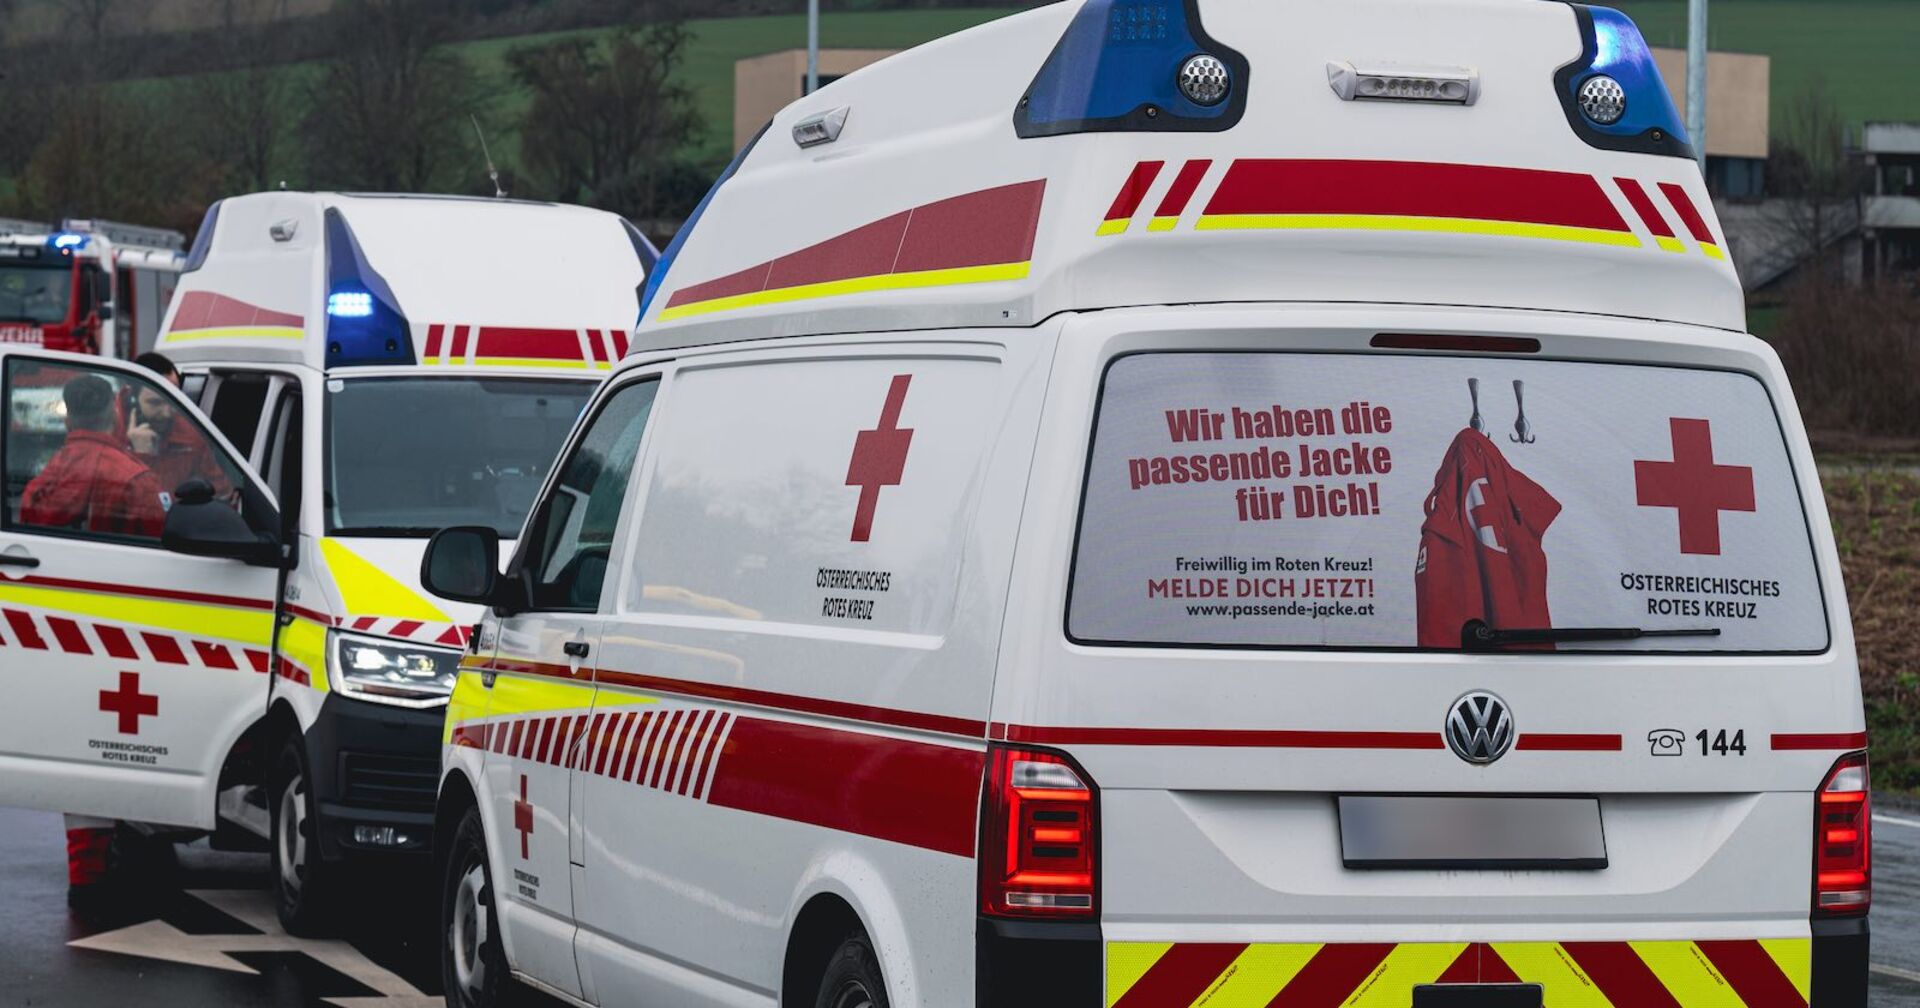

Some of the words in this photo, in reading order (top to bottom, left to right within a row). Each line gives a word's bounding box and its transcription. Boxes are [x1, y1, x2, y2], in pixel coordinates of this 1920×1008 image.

[1165, 408, 1225, 442] Wir
[1231, 405, 1336, 439] haben
[1341, 401, 1393, 435] die
[1128, 446, 1291, 490] passende
[1298, 442, 1393, 477] Jacke
[1235, 486, 1285, 522] für
[1293, 482, 1381, 518] Dich!
[1175, 556, 1248, 575] Freiwillig
[1252, 556, 1271, 572] im
[1275, 557, 1320, 572] Roten
[1324, 557, 1373, 572] Kreuz!
[816, 567, 891, 592] ÖSTERREICHISCHES
[1148, 578, 1229, 599] MELDE
[1236, 578, 1295, 598] DICH
[1301, 578, 1374, 598] JETZT!
[1620, 572, 1780, 597] ÖSTERREICHISCHES
[822, 597, 847, 618] ROTES
[847, 599, 874, 620] KREUZ
[1186, 601, 1375, 620] www.passende-jacke.at
[1647, 598, 1700, 616] ROTES
[1705, 601, 1757, 619] KREUZ
[1696, 729, 1747, 756] 144
